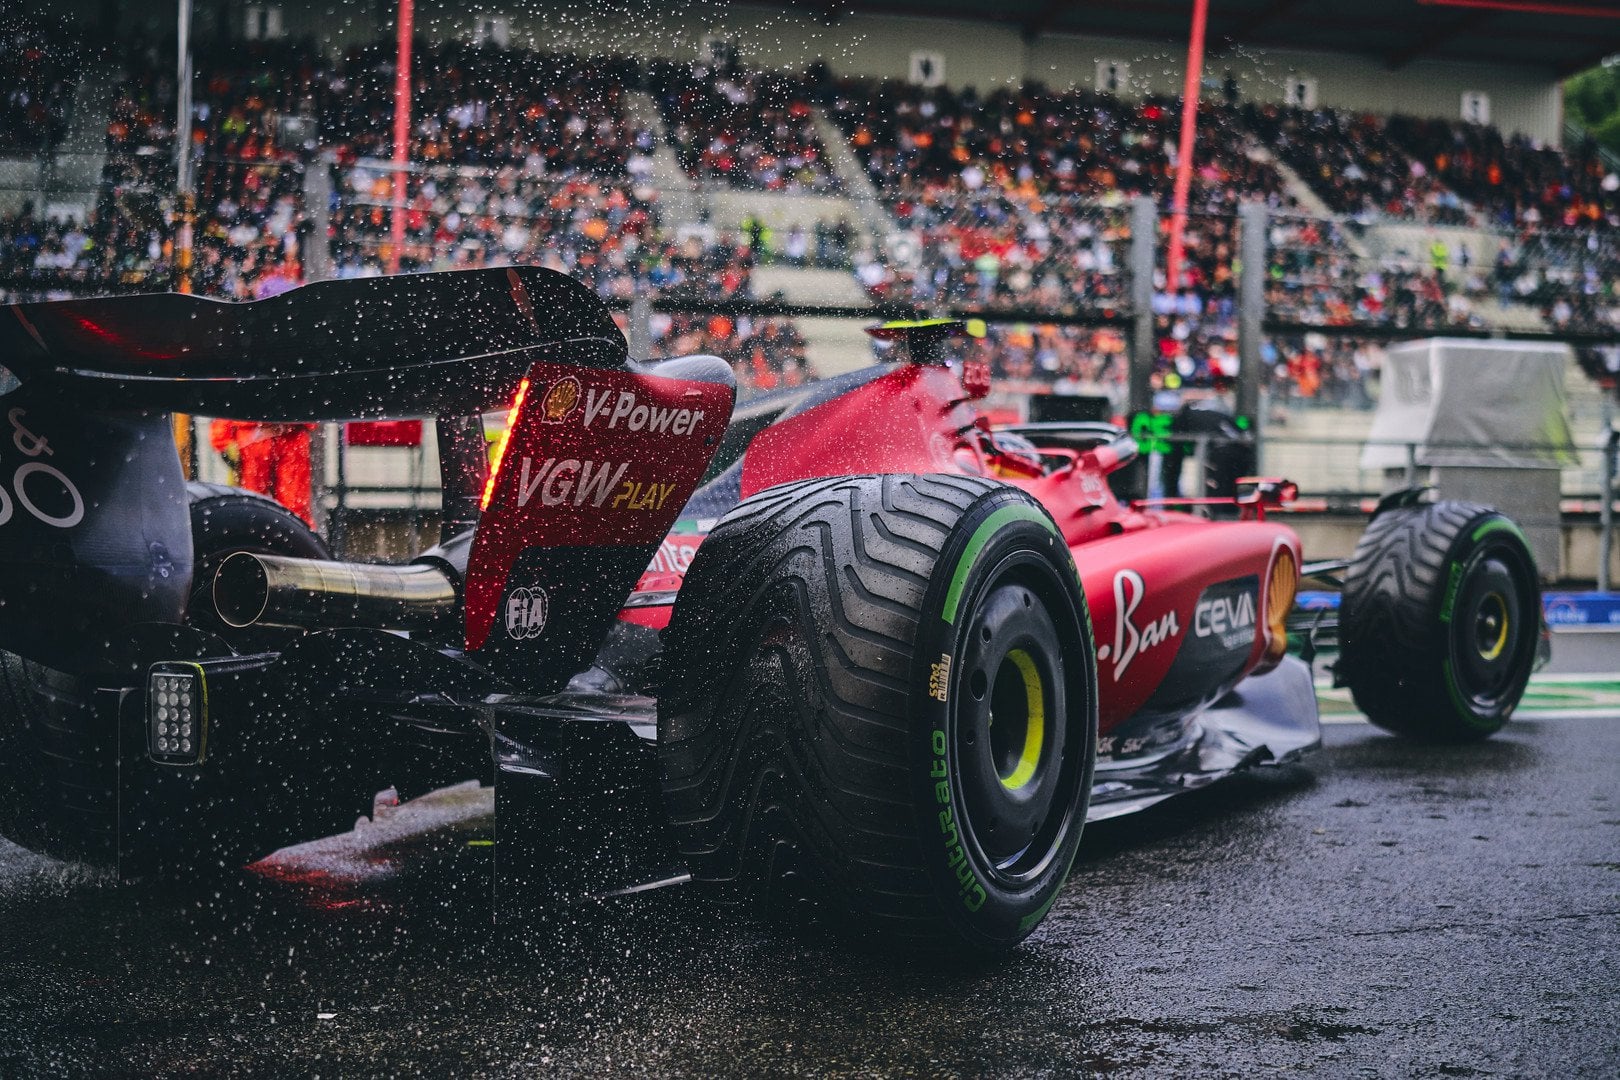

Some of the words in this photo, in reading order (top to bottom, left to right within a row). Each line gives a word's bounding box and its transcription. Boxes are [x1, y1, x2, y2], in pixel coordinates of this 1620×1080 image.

[583, 388, 704, 436] V-Power
[517, 457, 629, 508] VGW
[612, 481, 676, 510] PLAY
[930, 729, 987, 913] Cinturato
